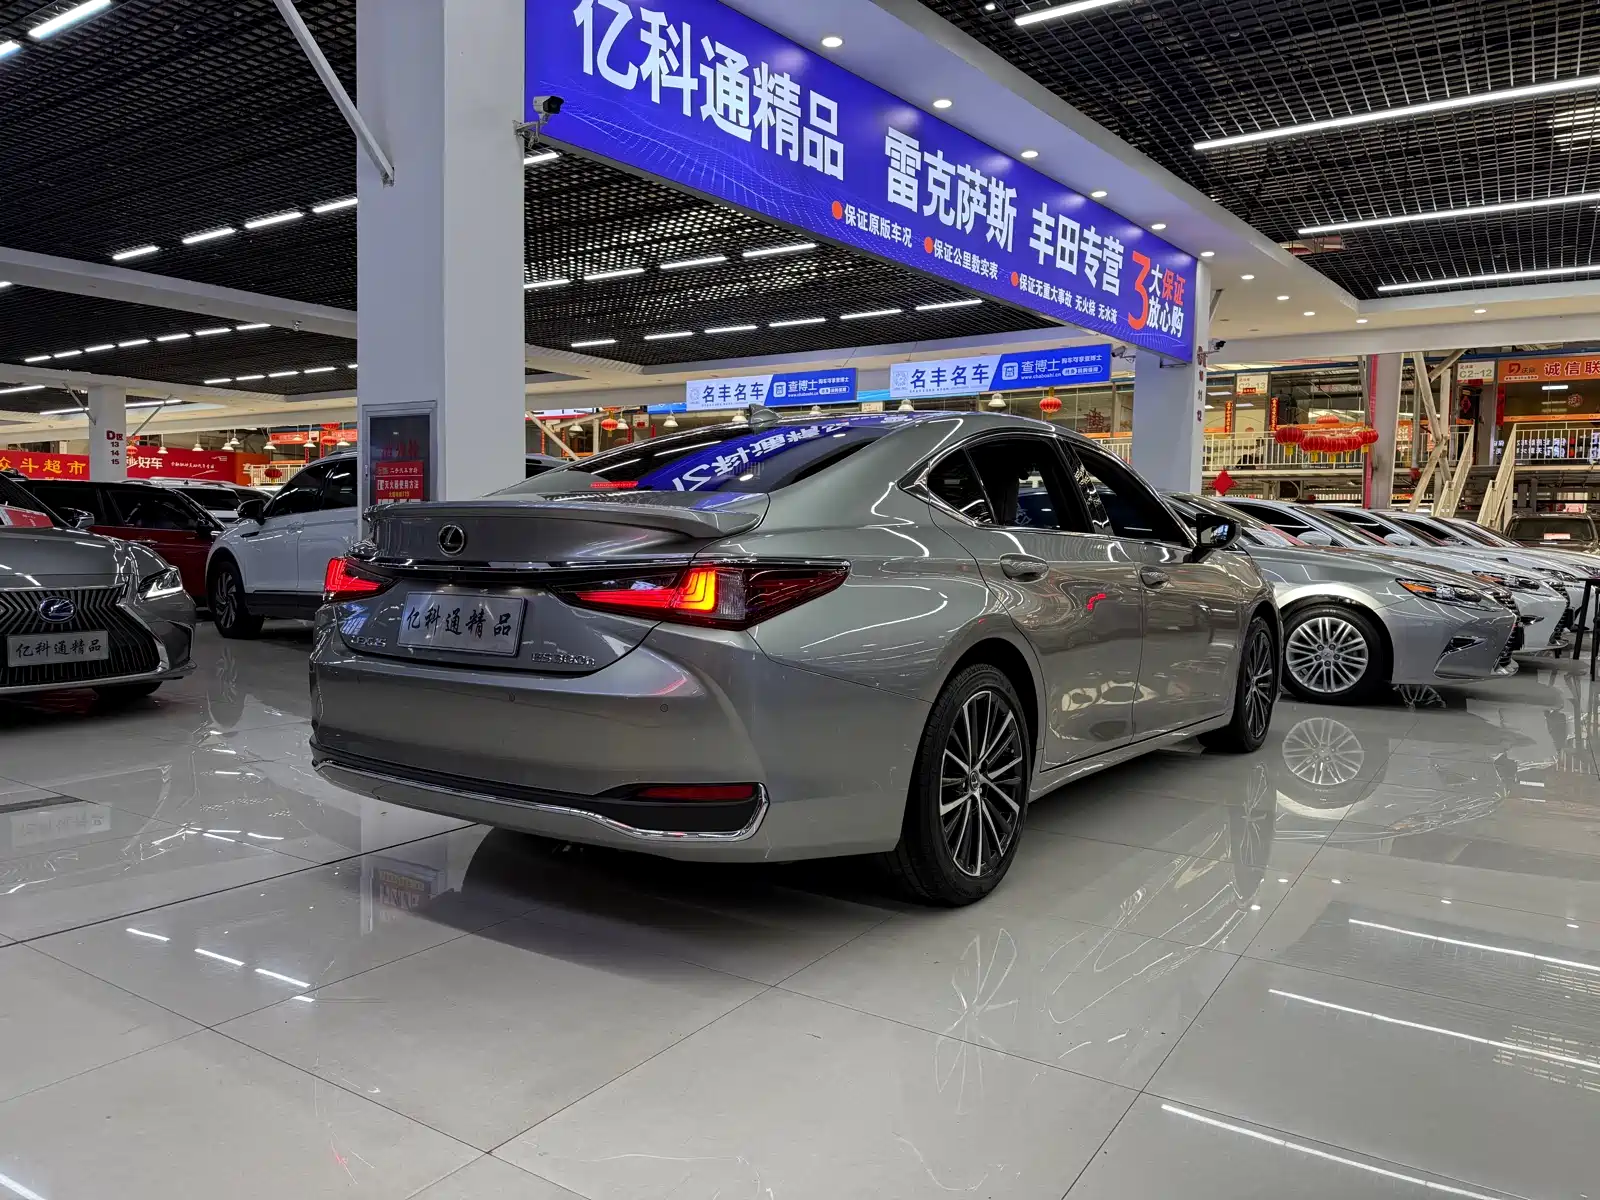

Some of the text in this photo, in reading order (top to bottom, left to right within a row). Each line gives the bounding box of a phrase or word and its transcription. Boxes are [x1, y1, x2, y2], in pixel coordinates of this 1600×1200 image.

[573, 0, 1124, 296] 亿科通精品 雷克萨斯 丰田专营
[844, 203, 913, 248] 保证原版车况
[933, 237, 999, 281] 保证公里数实表
[1019, 272, 1073, 308] 保证无重大事故
[1075, 295, 1096, 317] 无火烧
[1128, 250, 1151, 331] 3
[1146, 295, 1184, 339] 放心购
[910, 364, 988, 389] 名丰名车
[1021, 359, 1060, 373] 查博士
[1544, 360, 1600, 376] 诚信联
[702, 382, 764, 403] 名丰名车
[788, 379, 818, 393] 查博士
[406, 604, 512, 638] 亿科通精品
[16, 638, 102, 658] 亿科通精品
